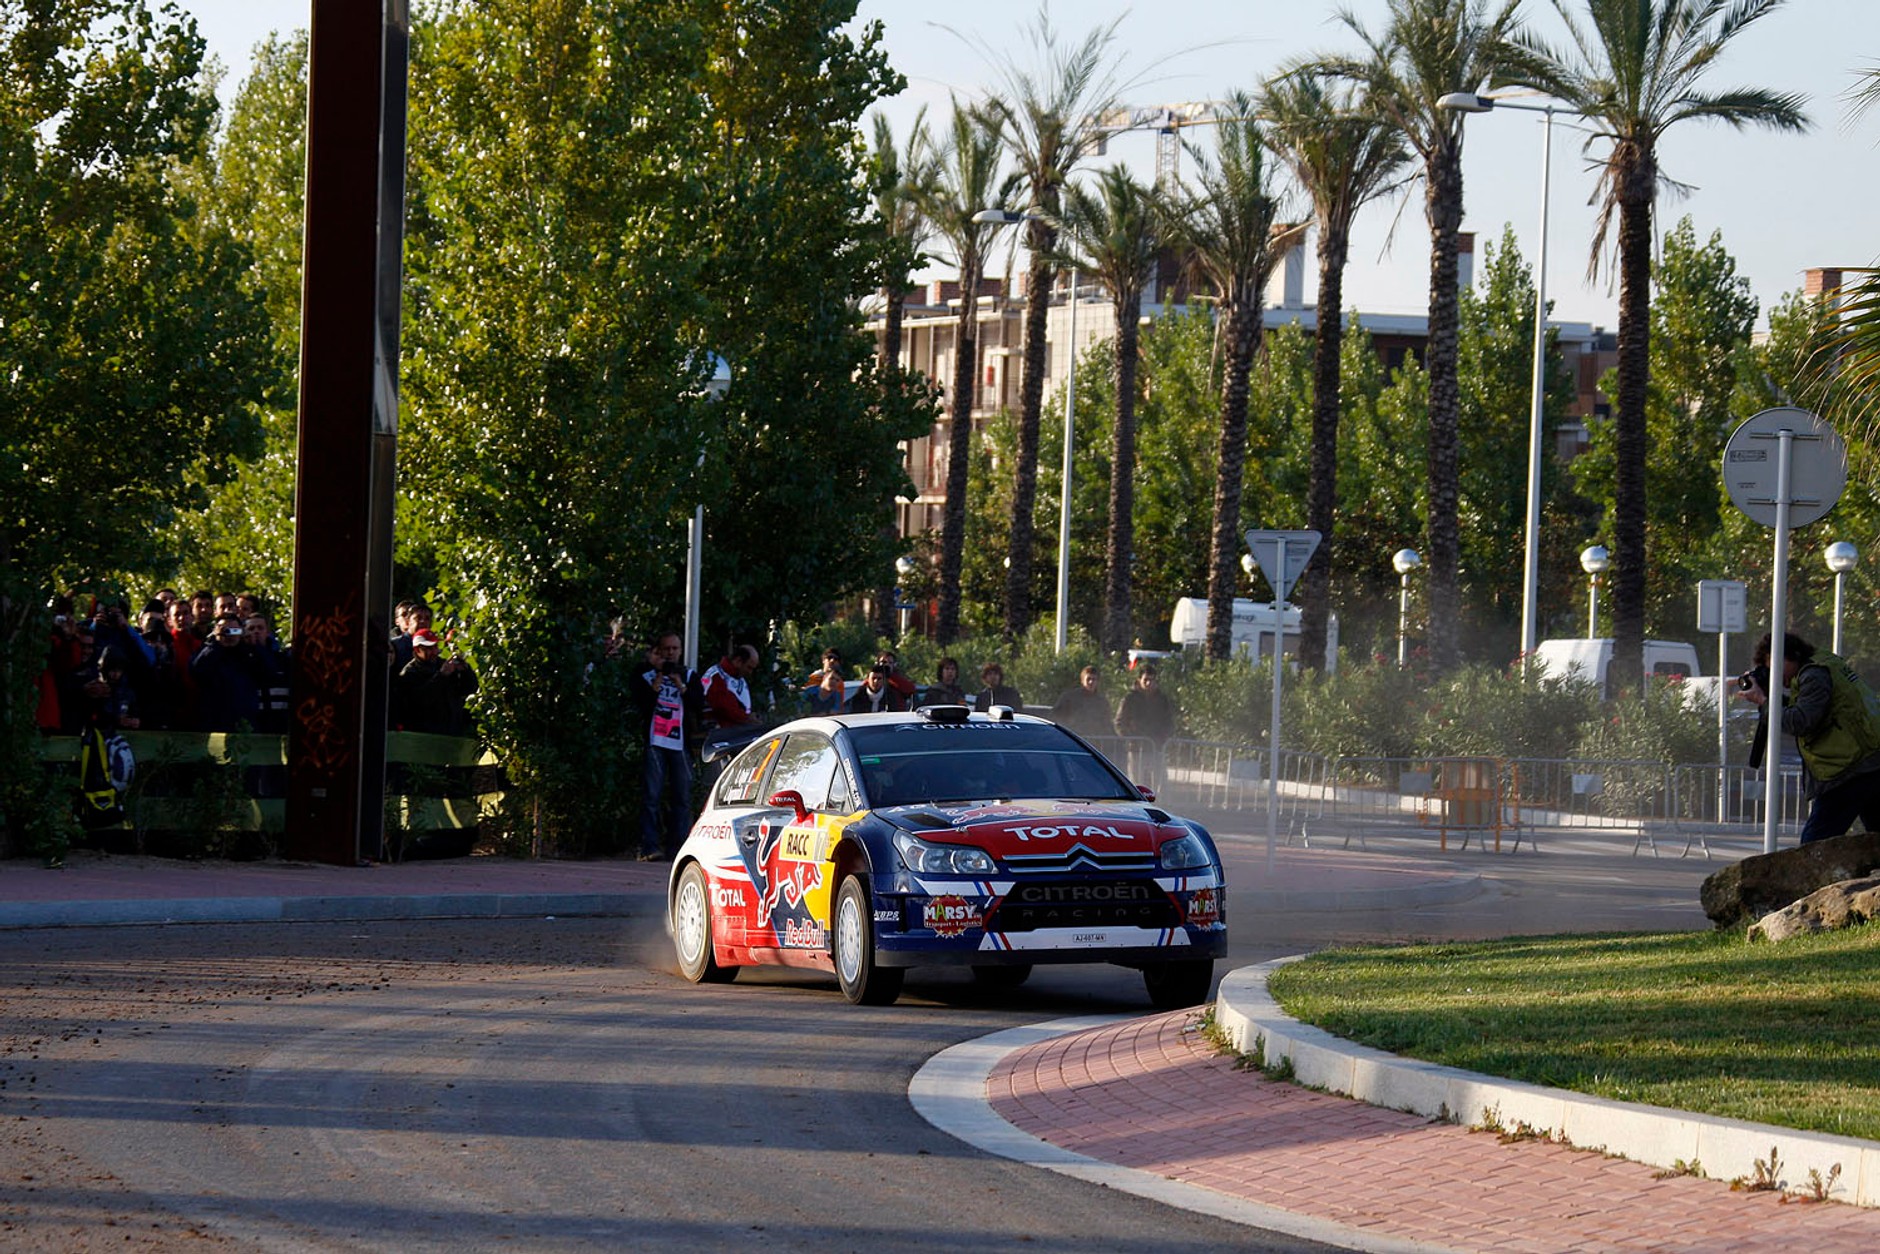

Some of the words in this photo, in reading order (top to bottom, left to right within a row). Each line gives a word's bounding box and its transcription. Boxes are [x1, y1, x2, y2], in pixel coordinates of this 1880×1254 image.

[1003, 825, 1134, 841] TOTAL
[786, 833, 809, 856] RACC
[708, 883, 746, 907] TOTAL
[1021, 881, 1150, 902] CITROËN
[923, 904, 977, 921] MARSY
[1022, 907, 1151, 918] RACING
[785, 918, 804, 945] Red
[804, 918, 825, 947] Bull
